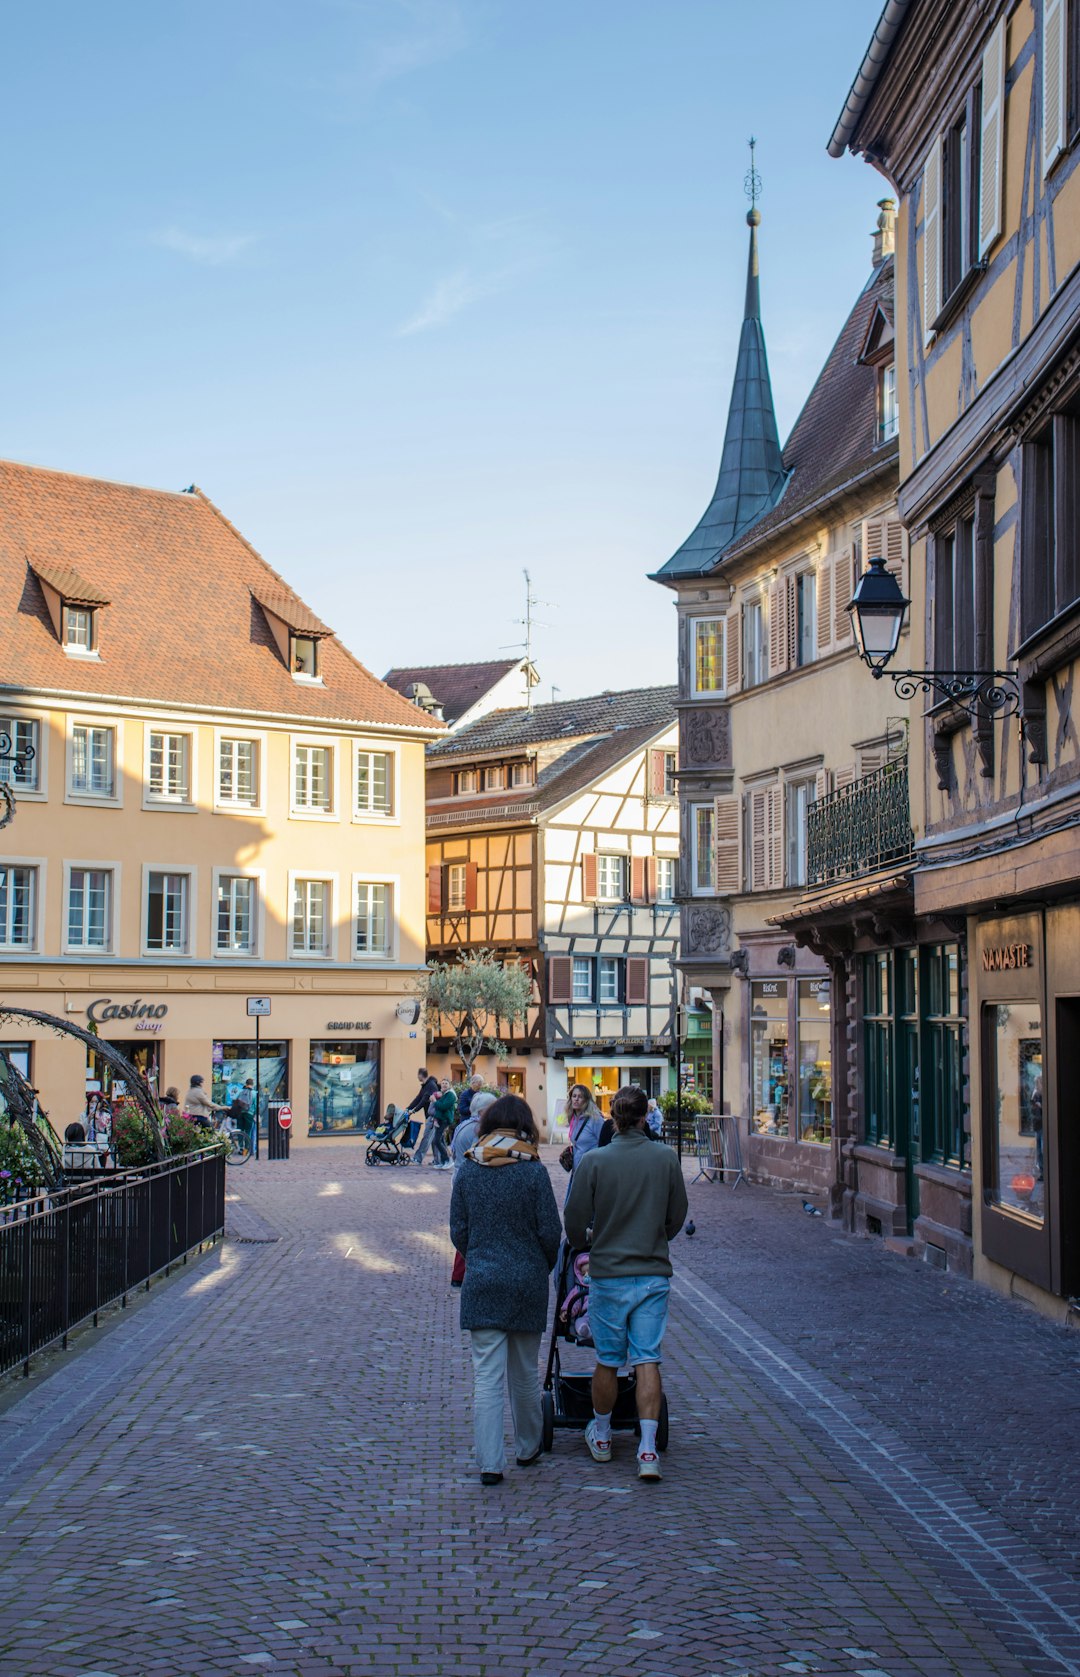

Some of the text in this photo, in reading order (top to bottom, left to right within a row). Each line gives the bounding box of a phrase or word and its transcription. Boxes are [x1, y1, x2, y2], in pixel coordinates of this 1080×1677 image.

[982, 943, 1028, 972] NAMASTE
[87, 998, 168, 1024] Casino
[135, 1020, 163, 1035] shop
